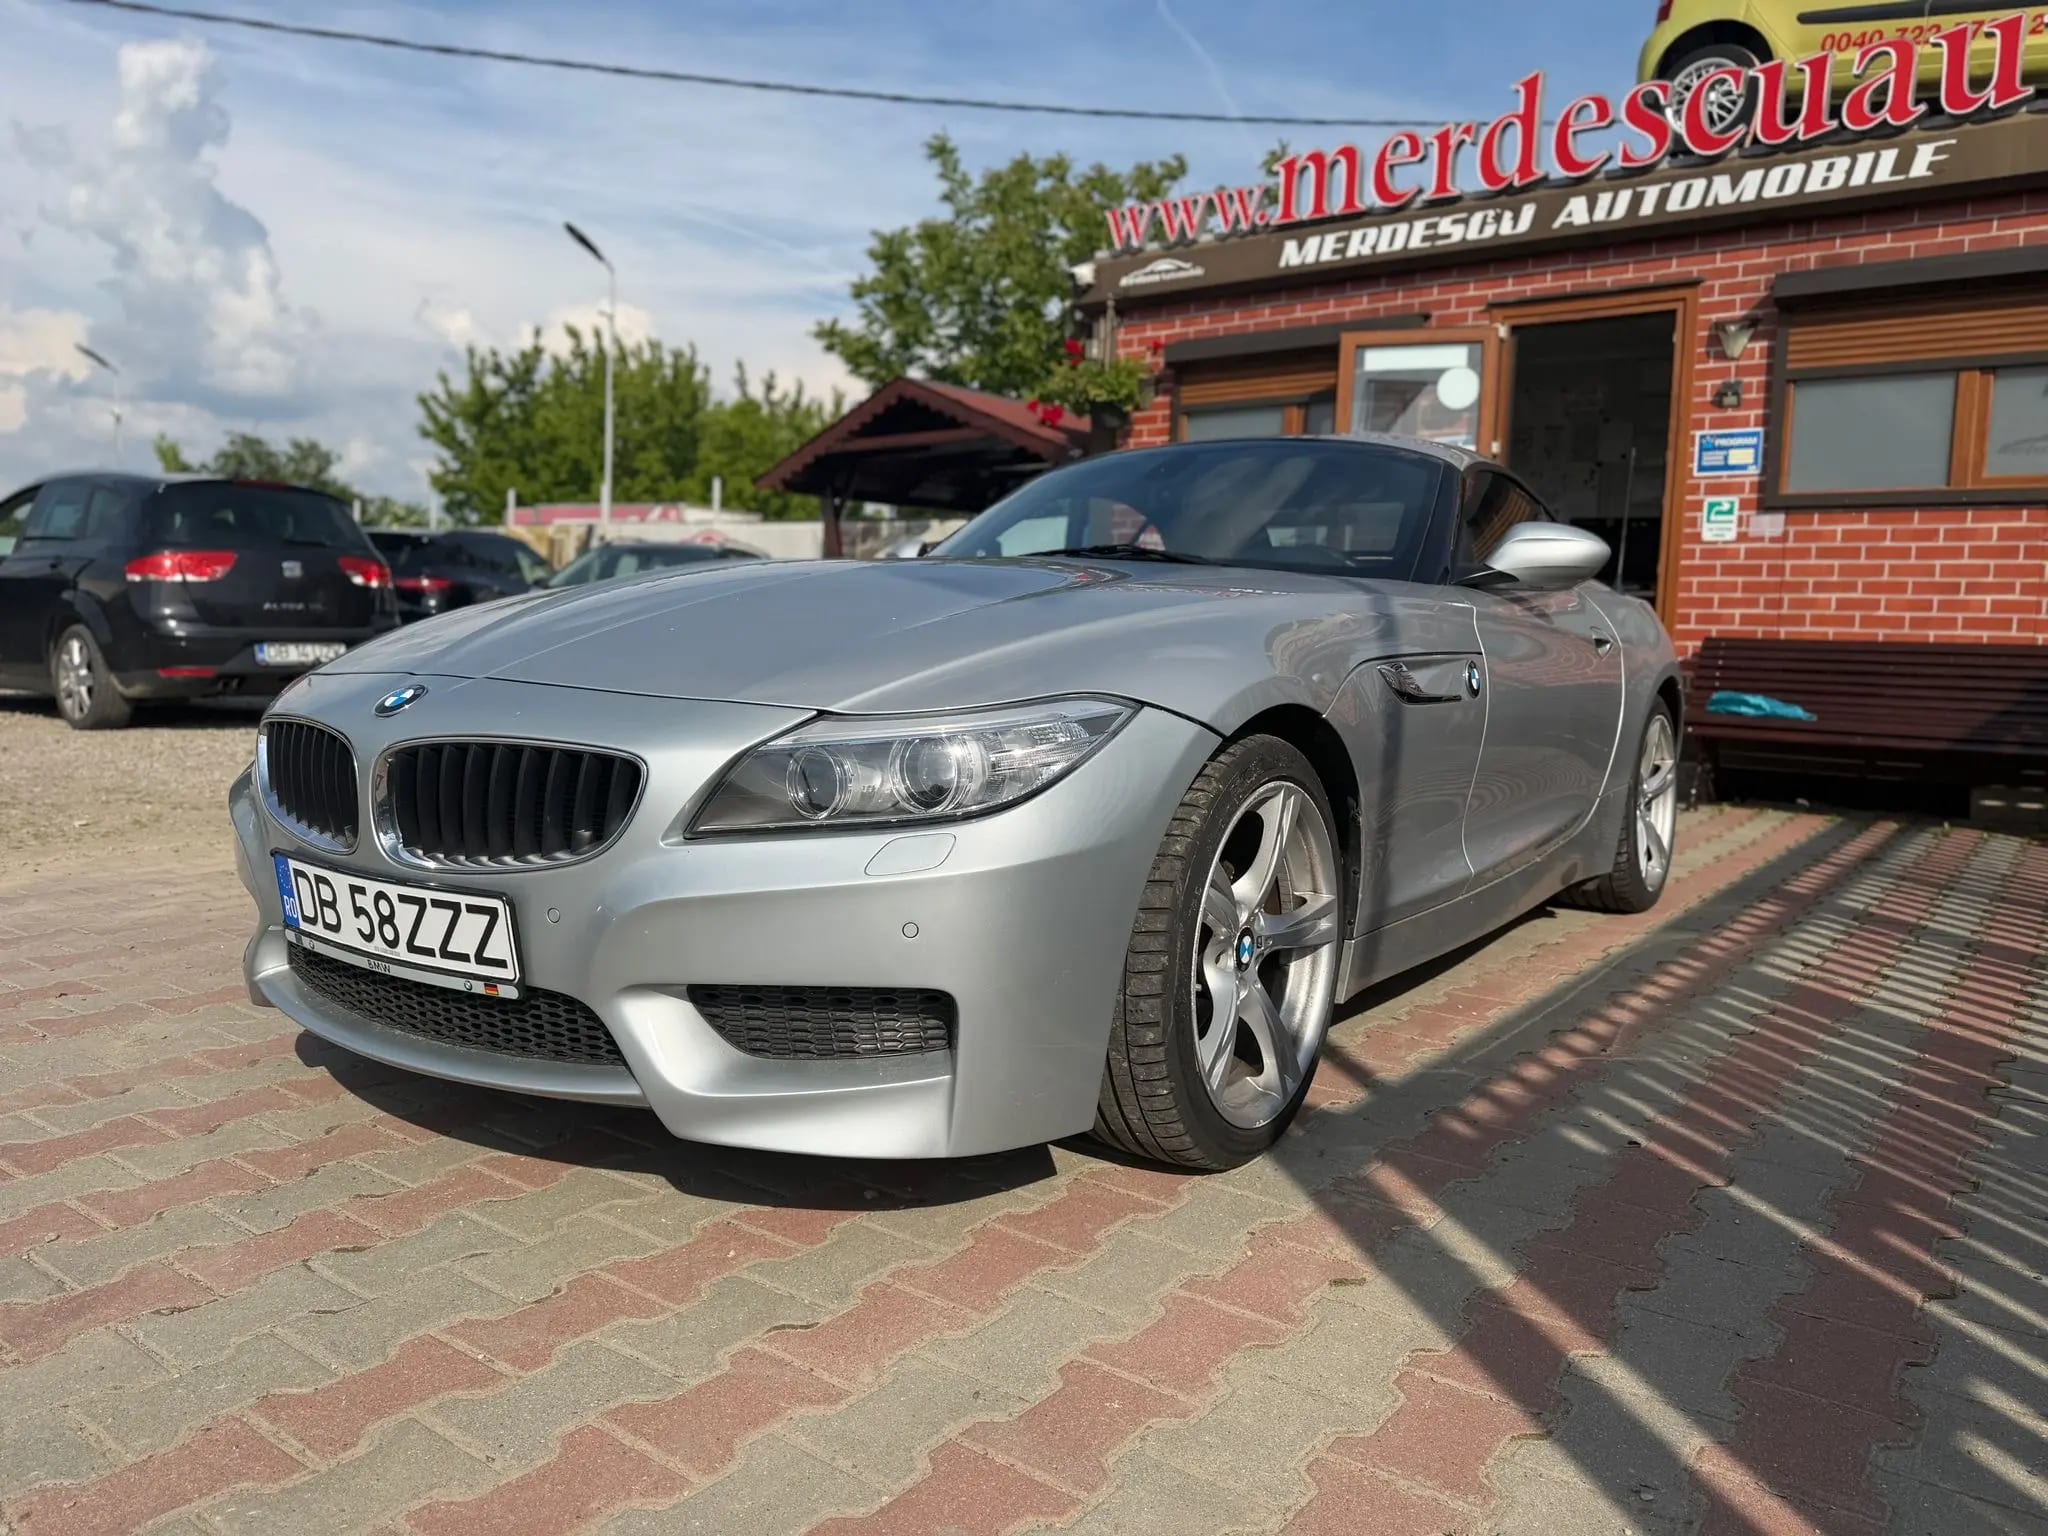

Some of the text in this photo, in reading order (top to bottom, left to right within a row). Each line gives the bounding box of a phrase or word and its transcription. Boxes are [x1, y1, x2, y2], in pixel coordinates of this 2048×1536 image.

[1106, 12, 2048, 251] www.merdescuau
[1279, 139, 1958, 268] MERDESCU AUTOMOBILE
[283, 895, 298, 919] RO
[292, 867, 342, 933] DB
[367, 958, 391, 974] BMW
